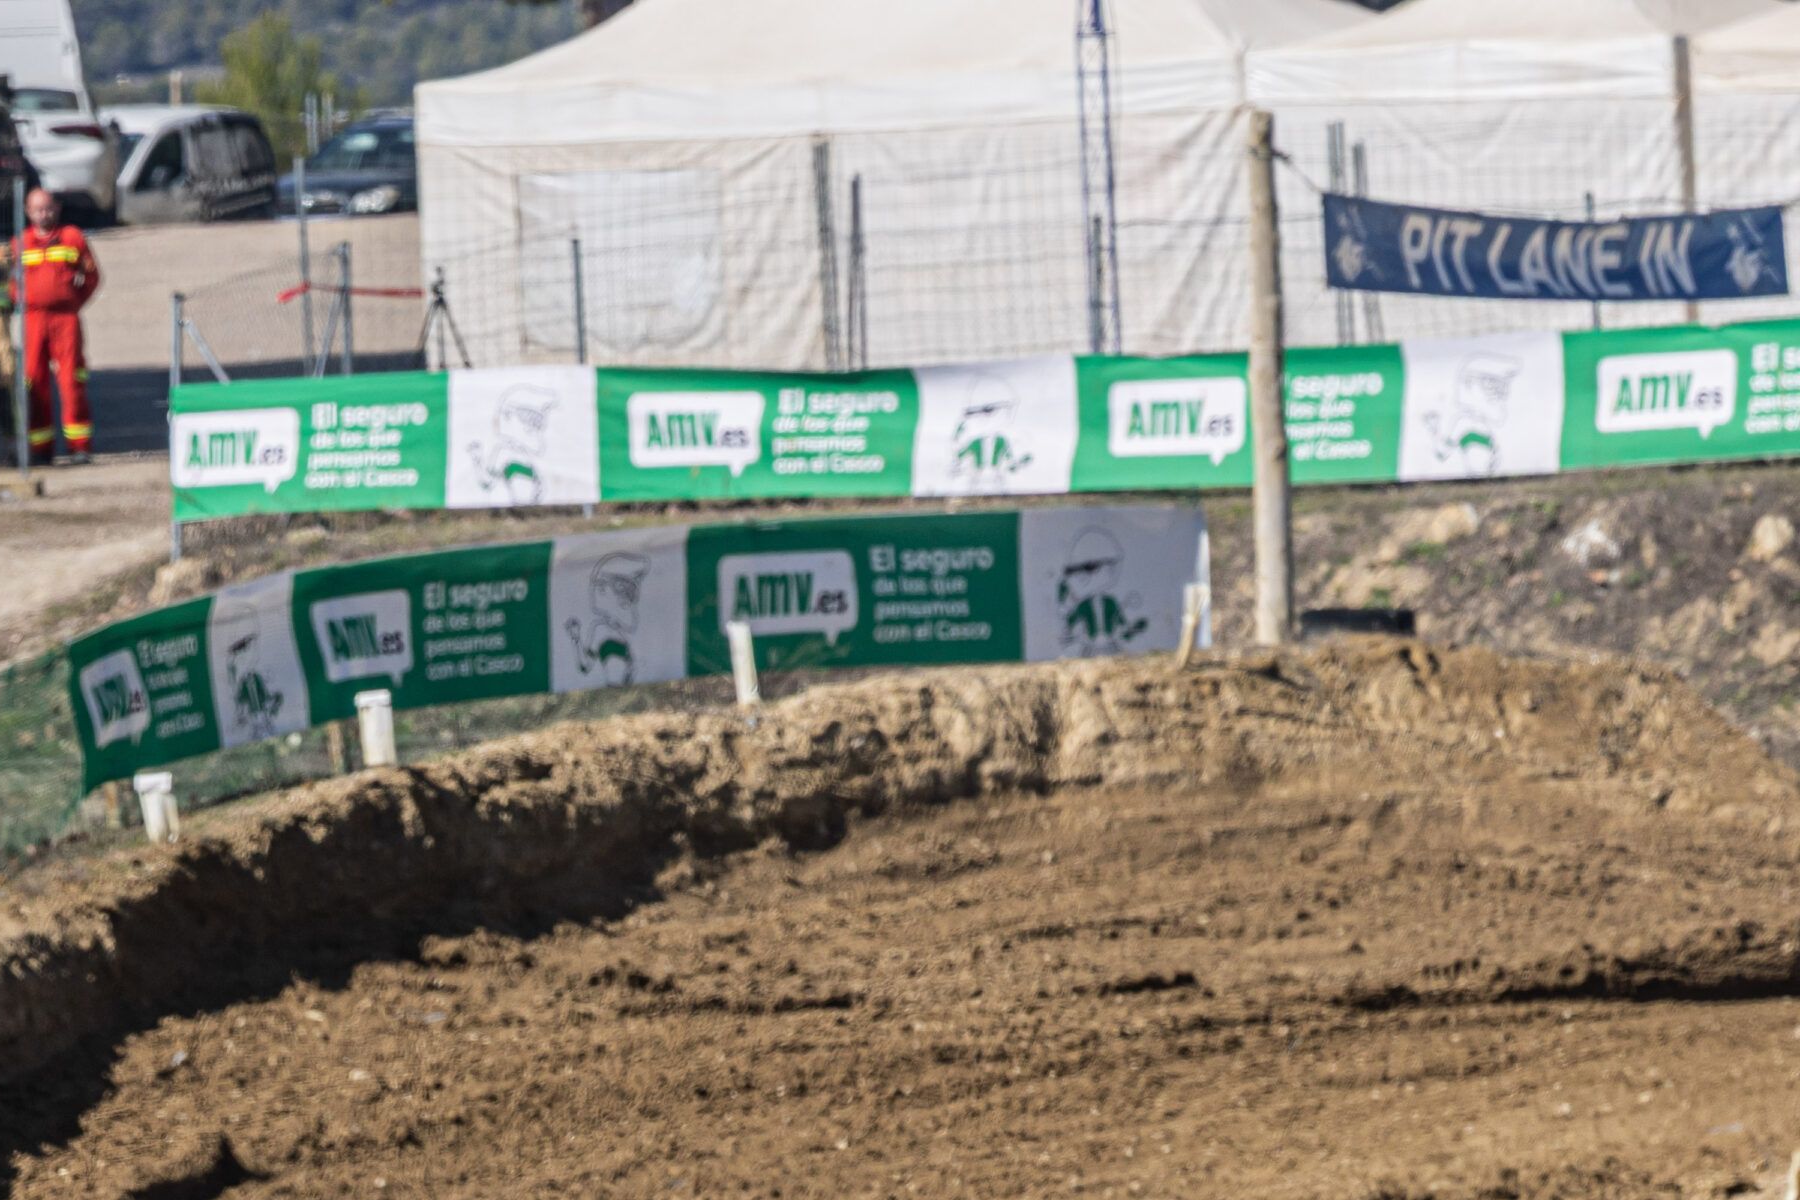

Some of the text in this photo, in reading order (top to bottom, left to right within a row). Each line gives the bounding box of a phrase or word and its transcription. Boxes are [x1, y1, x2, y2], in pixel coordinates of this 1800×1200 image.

[1402, 213, 1697, 297] PIT LANE IN
[1291, 373, 1383, 400] seguro
[311, 401, 428, 430] El seguro
[778, 388, 899, 419] El seguro
[870, 544, 995, 576] El seguro
[423, 579, 529, 610] El seguro
